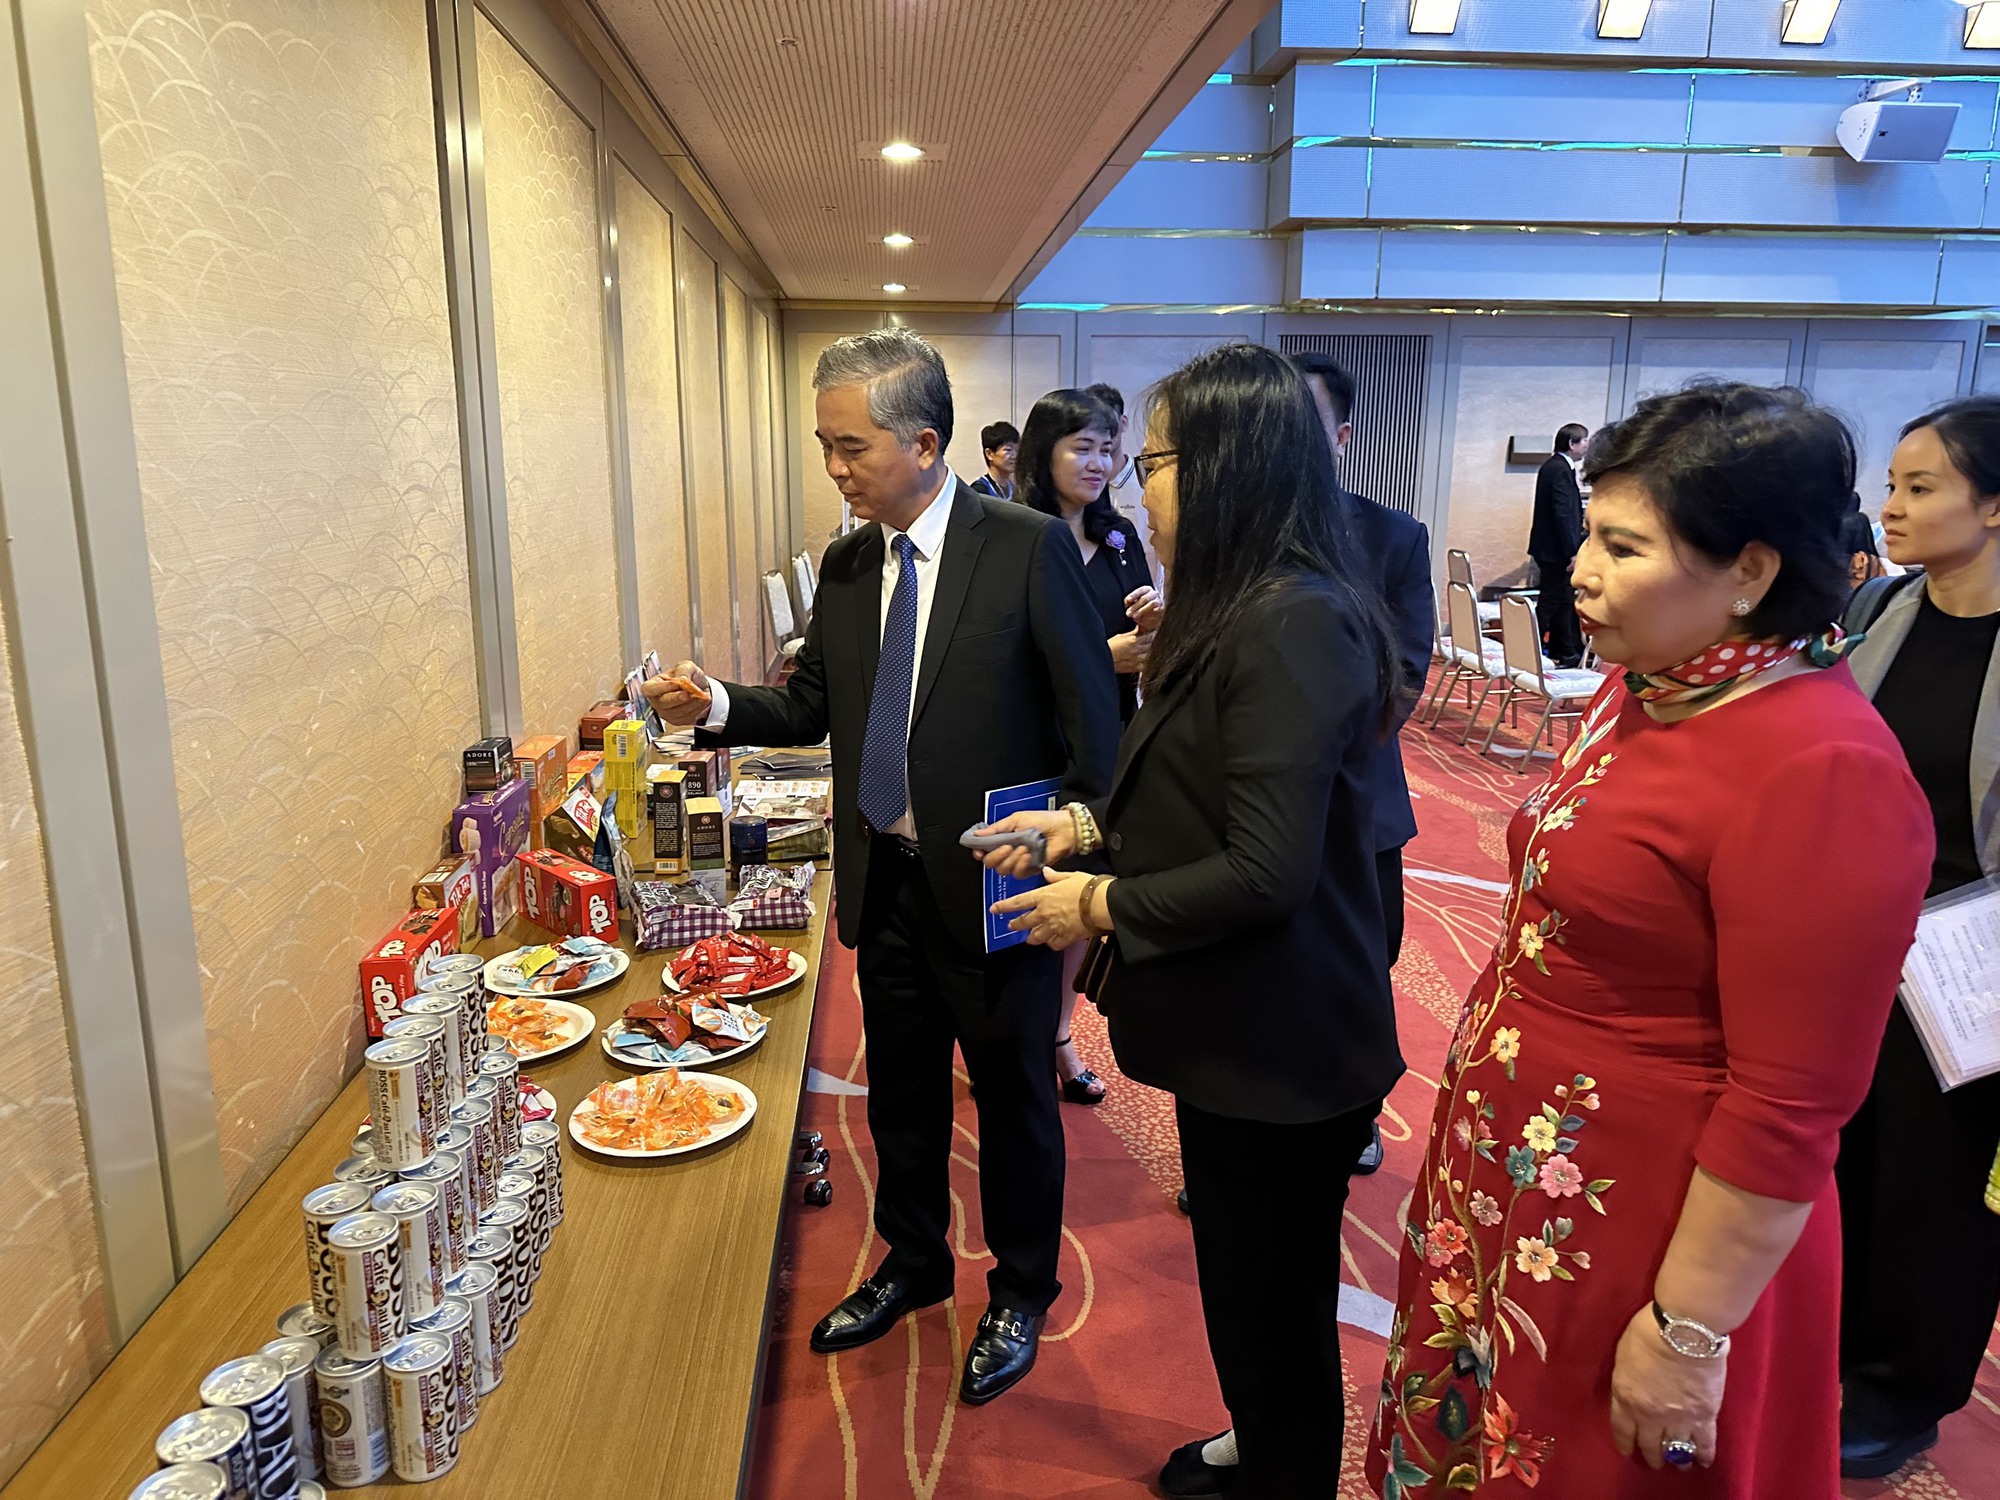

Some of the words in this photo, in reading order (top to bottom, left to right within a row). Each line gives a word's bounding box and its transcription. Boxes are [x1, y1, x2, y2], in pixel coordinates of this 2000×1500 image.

[524, 864, 542, 920] TOP
[568, 870, 604, 882] TOP
[590, 894, 612, 934] TOP
[378, 940, 406, 958] TOP
[372, 975, 402, 1023] TOP
[378, 1069, 387, 1093] BOSS
[503, 1074, 514, 1104] Café
[508, 1134, 518, 1154] Lait
[481, 1121, 491, 1152] Café
[486, 1184, 496, 1206] Lait
[452, 1176, 462, 1210] Café
[546, 1146, 554, 1173] Café
[550, 1200, 558, 1220] Lait
[372, 1250, 386, 1284] Café
[378, 1307, 388, 1322] au
[380, 1322, 392, 1347] Lait
[460, 1326, 472, 1361] Café
[428, 1372, 444, 1408] Café
[432, 1426, 445, 1442] au
[434, 1442, 449, 1468] Lait
